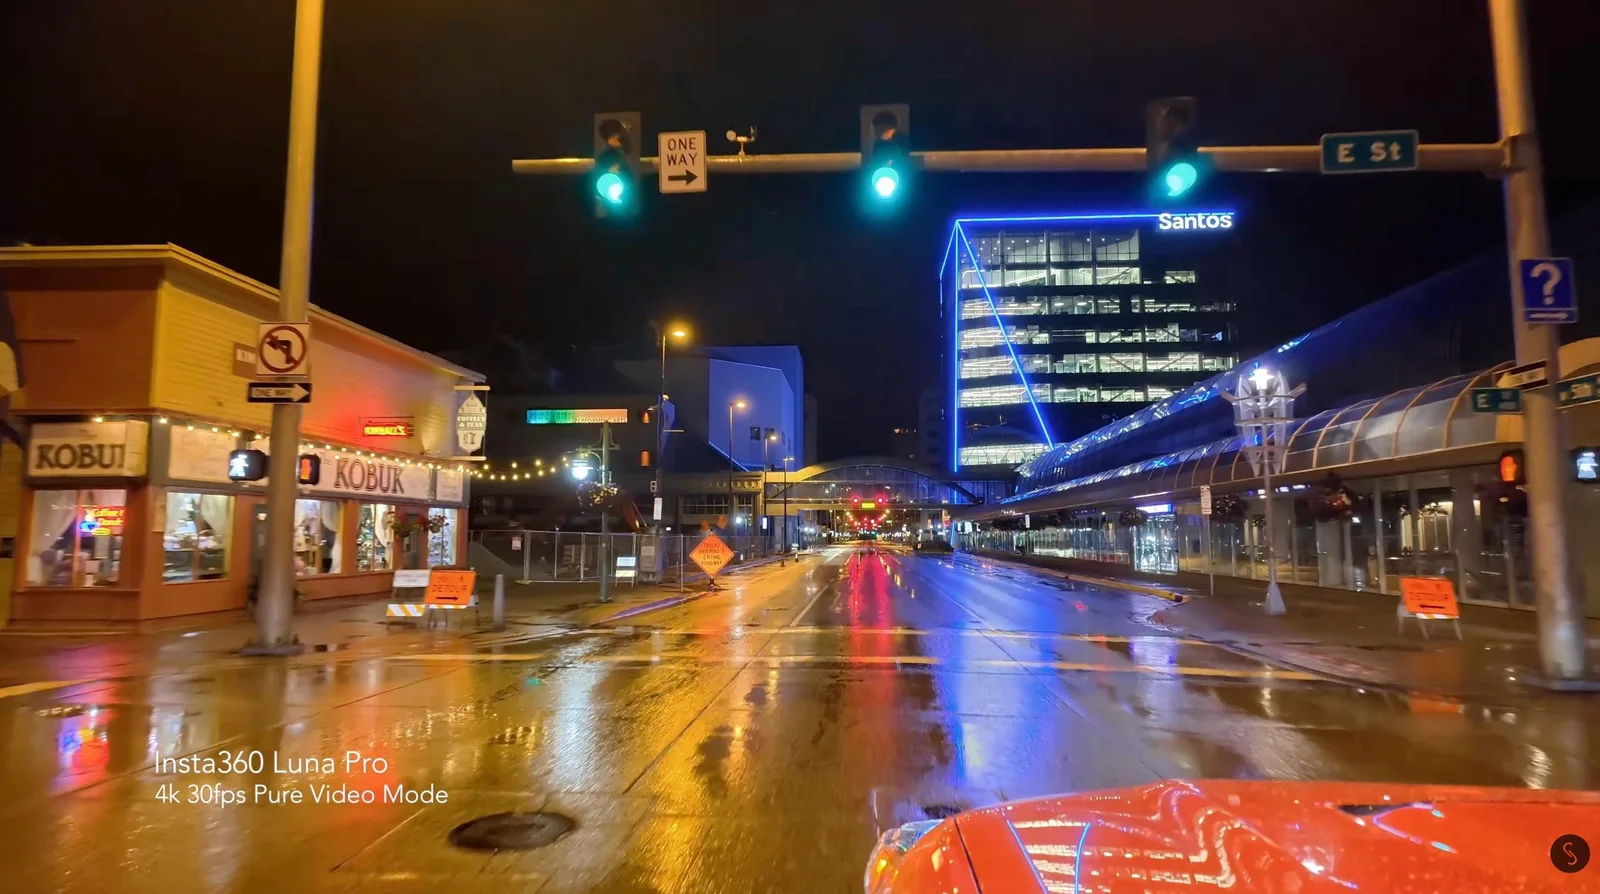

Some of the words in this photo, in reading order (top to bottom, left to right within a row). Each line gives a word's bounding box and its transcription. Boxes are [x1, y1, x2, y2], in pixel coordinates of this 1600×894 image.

[667, 136, 697, 151] ONE
[666, 152, 698, 166] WAY
[1337, 143, 1355, 163] E
[1370, 141, 1402, 162] St
[1159, 212, 1233, 230] Santos
[253, 388, 273, 397] ONE
[274, 388, 293, 397] WAY
[528, 410, 574, 422] CENTER
[333, 458, 405, 495] KOBUK
[431, 584, 469, 594] DETOUR
[1407, 591, 1449, 602] DETOUR
